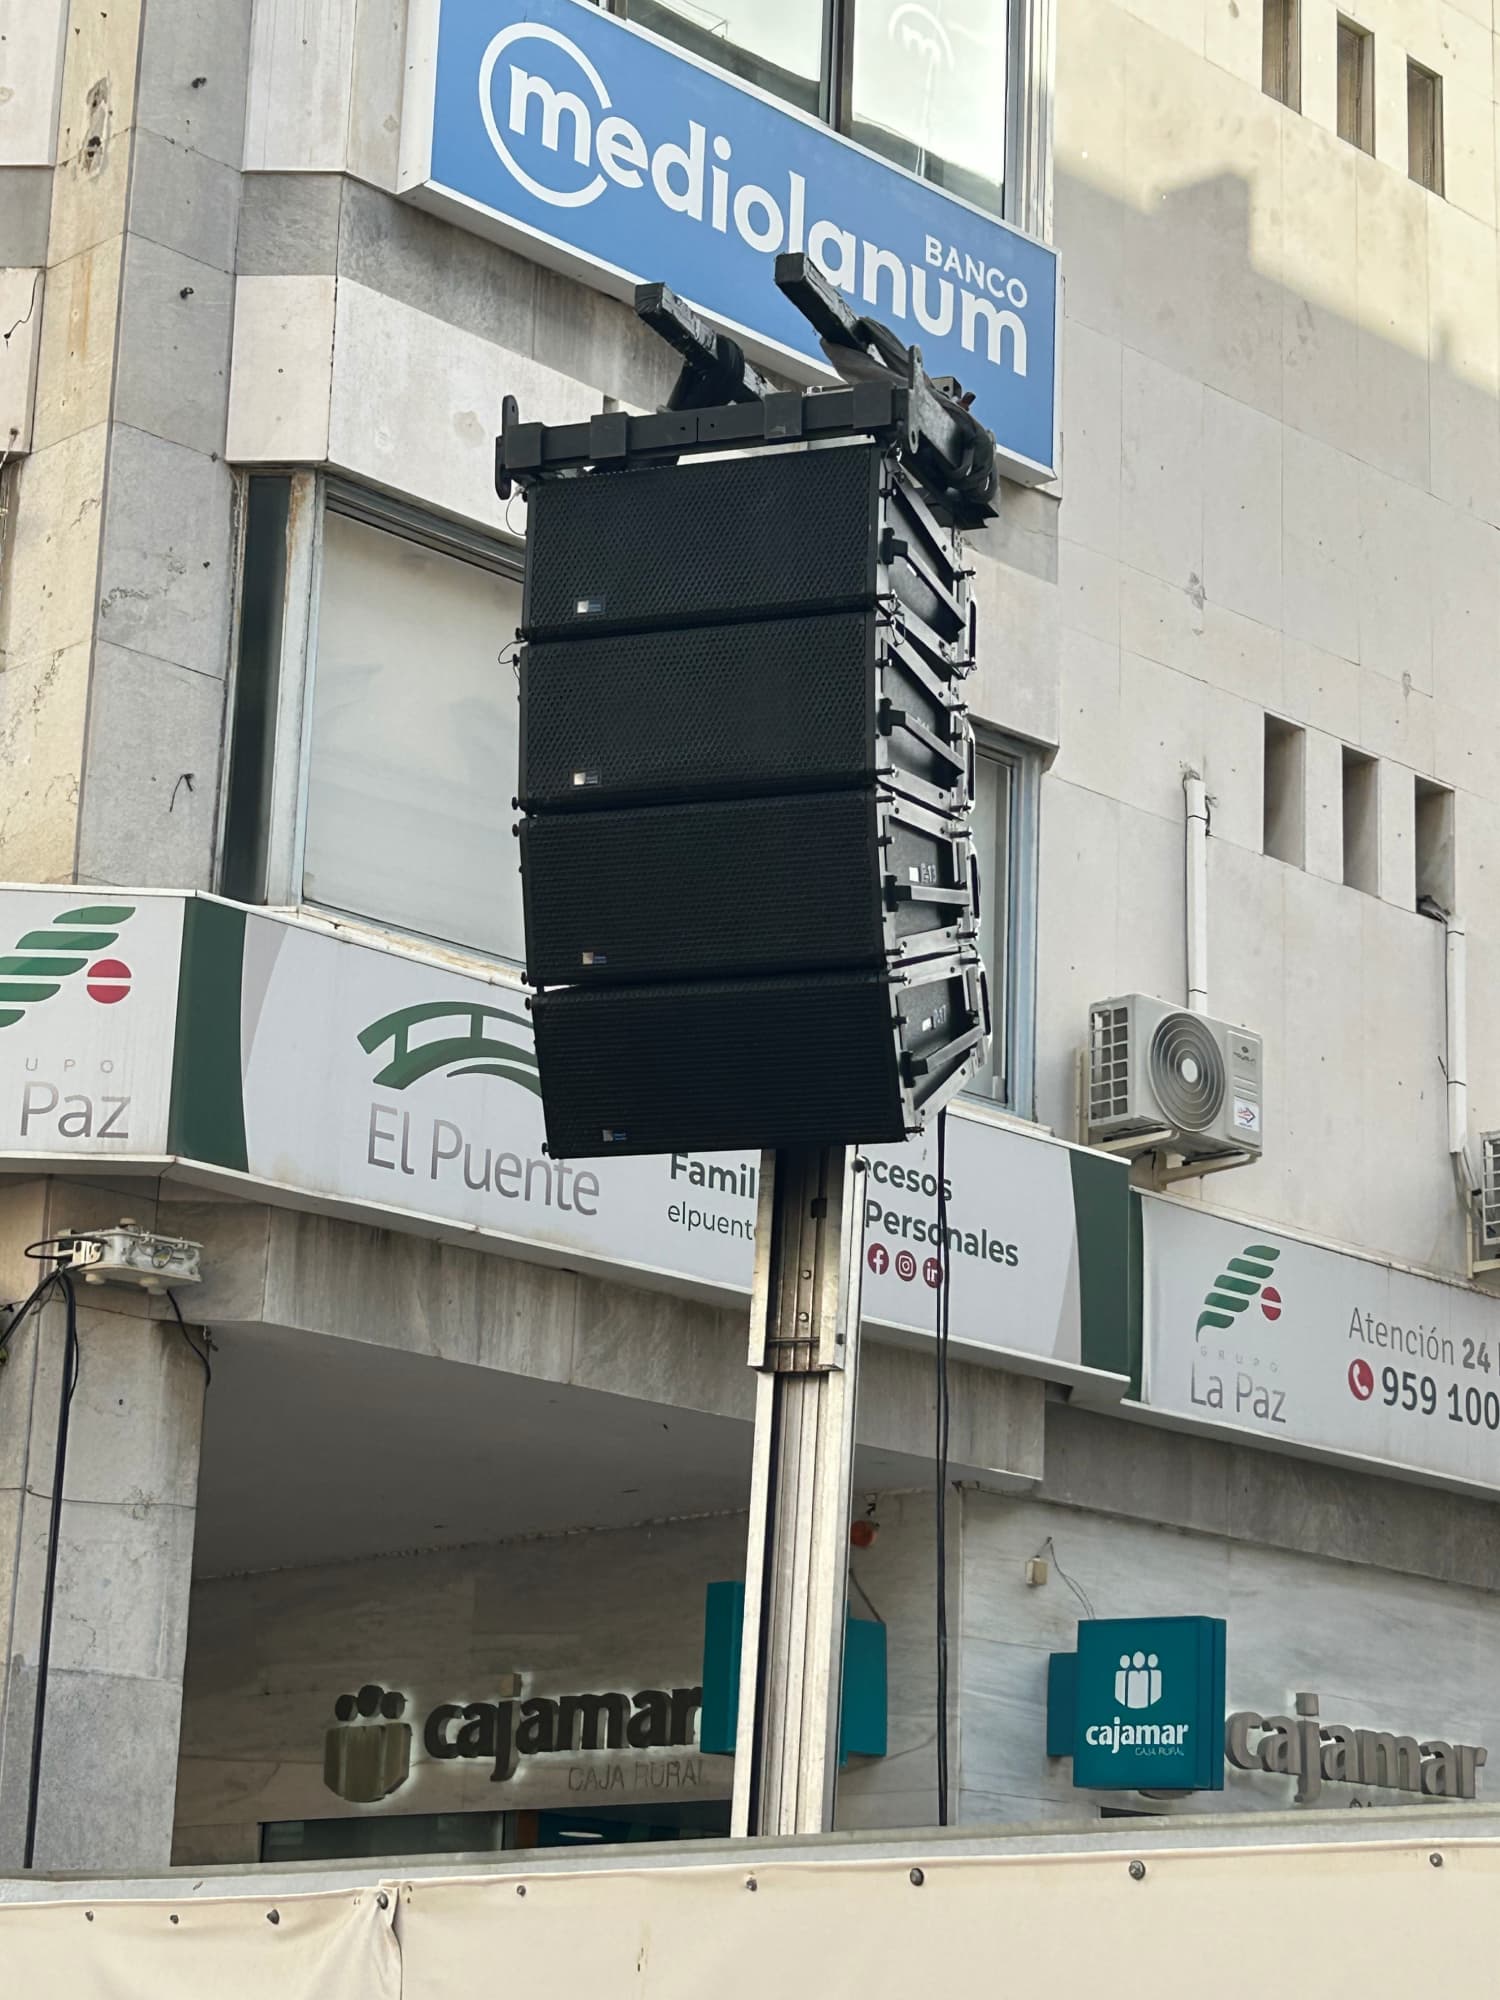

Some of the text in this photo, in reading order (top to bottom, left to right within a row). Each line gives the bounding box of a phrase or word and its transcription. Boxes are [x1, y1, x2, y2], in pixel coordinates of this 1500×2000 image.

[508, 64, 1027, 377] mediolanum
[925, 234, 1028, 309] BANCO
[25, 1057, 114, 1074] UPO
[20, 1081, 131, 1138] Paz
[367, 1102, 600, 1216] El Puente
[667, 1201, 757, 1240] elpuent
[671, 1152, 1019, 1267] Famil Personales
[1349, 1306, 1454, 1366] Atención
[1462, 1337, 1491, 1374] 24
[1191, 1361, 1286, 1424] La Paz
[1382, 1366, 1500, 1431] 959 100
[424, 1672, 703, 1781] cajamar
[1085, 1716, 1189, 1754] cajamar
[1225, 1692, 1488, 1803] cajamar
[568, 1764, 625, 1792] CAJA
